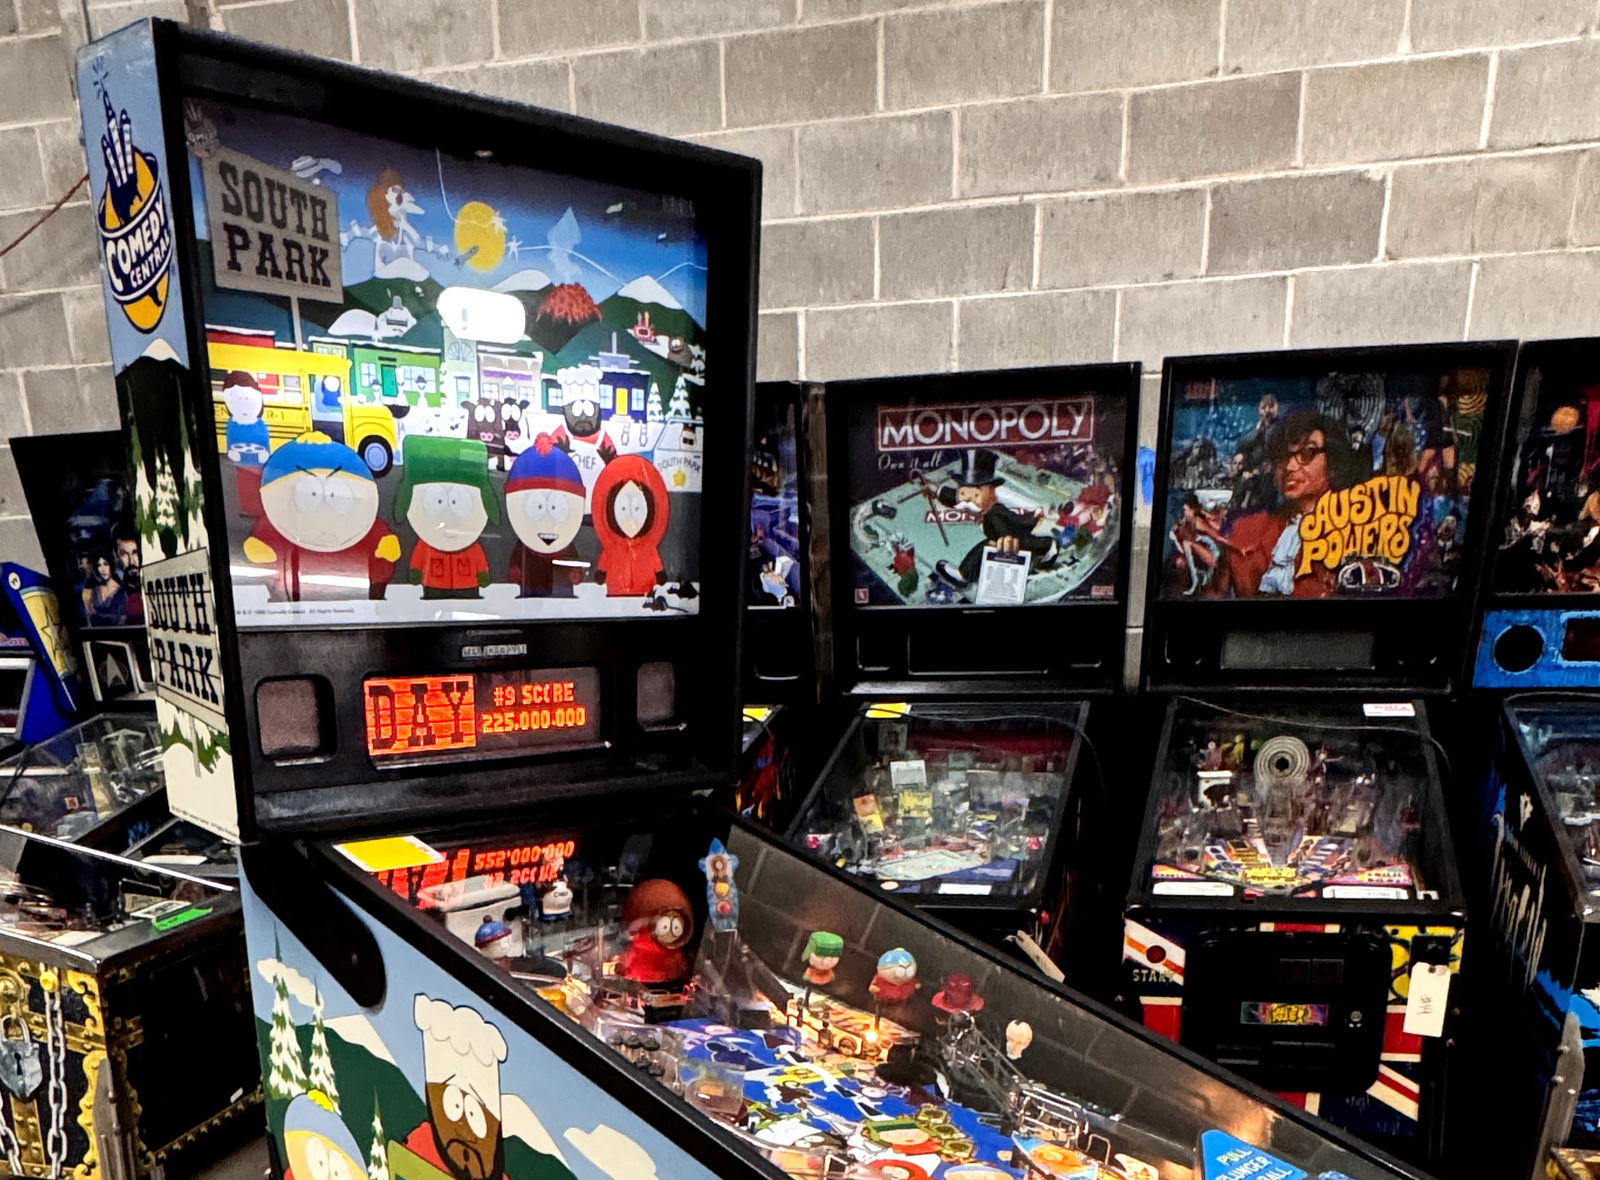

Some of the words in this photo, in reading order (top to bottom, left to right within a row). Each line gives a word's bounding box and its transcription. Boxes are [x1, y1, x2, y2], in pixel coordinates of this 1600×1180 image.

[218, 160, 329, 242] SOUTH
[105, 200, 165, 291] COMEDY
[129, 232, 171, 289] CENTRAL
[223, 222, 331, 288] PARK
[881, 399, 1087, 446] MONOPOLY
[1300, 475, 1420, 540] AUSTIN
[1294, 513, 1414, 578] POWERS
[145, 572, 211, 636] SOUTH
[153, 638, 220, 705] PARK
[1132, 968, 1176, 982] START
[1216, 1148, 1253, 1167] PULL
